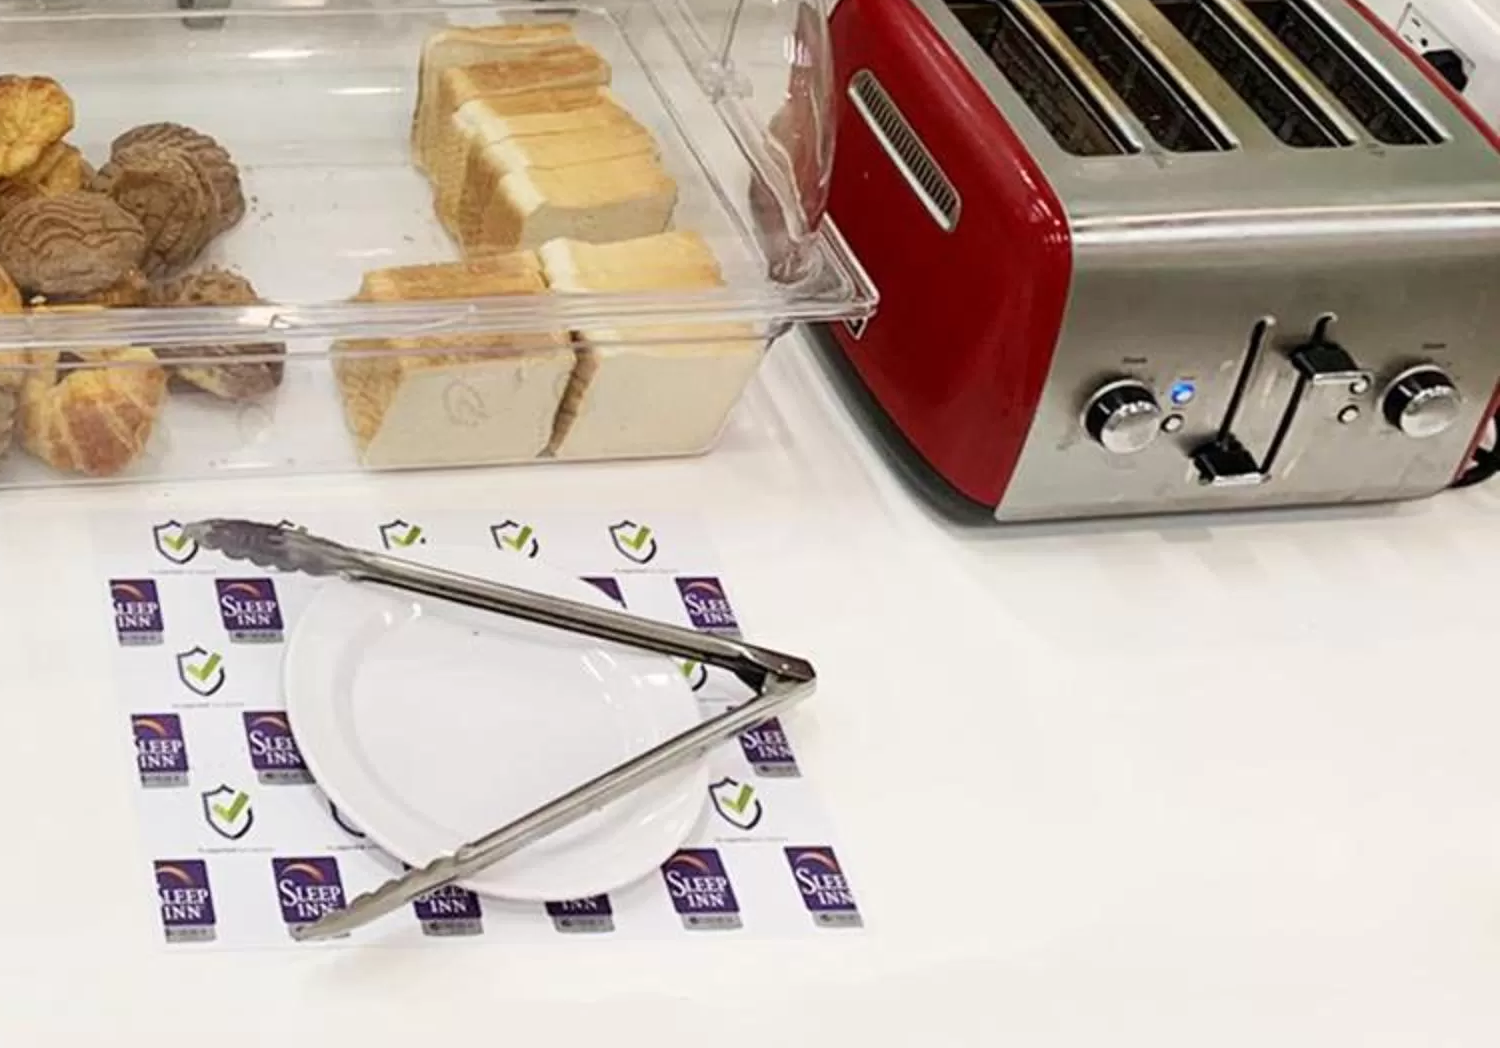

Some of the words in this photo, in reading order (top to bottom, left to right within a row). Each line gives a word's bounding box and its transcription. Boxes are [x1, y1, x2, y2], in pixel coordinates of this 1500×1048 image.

[115, 601, 159, 615] LEEP
[221, 595, 277, 617] SLEEP
[685, 593, 729, 616] SLEE
[118, 616, 152, 628] INN
[237, 614, 271, 626] INN
[138, 739, 183, 754] LEEP
[140, 755, 176, 768] INN
[666, 869, 728, 898] SLEEP
[796, 867, 849, 895] SLEE
[160, 888, 209, 904] LEEP
[279, 879, 342, 907] SLEEP
[687, 893, 725, 908] INN
[164, 905, 202, 920] INN
[430, 899, 467, 913] INN
